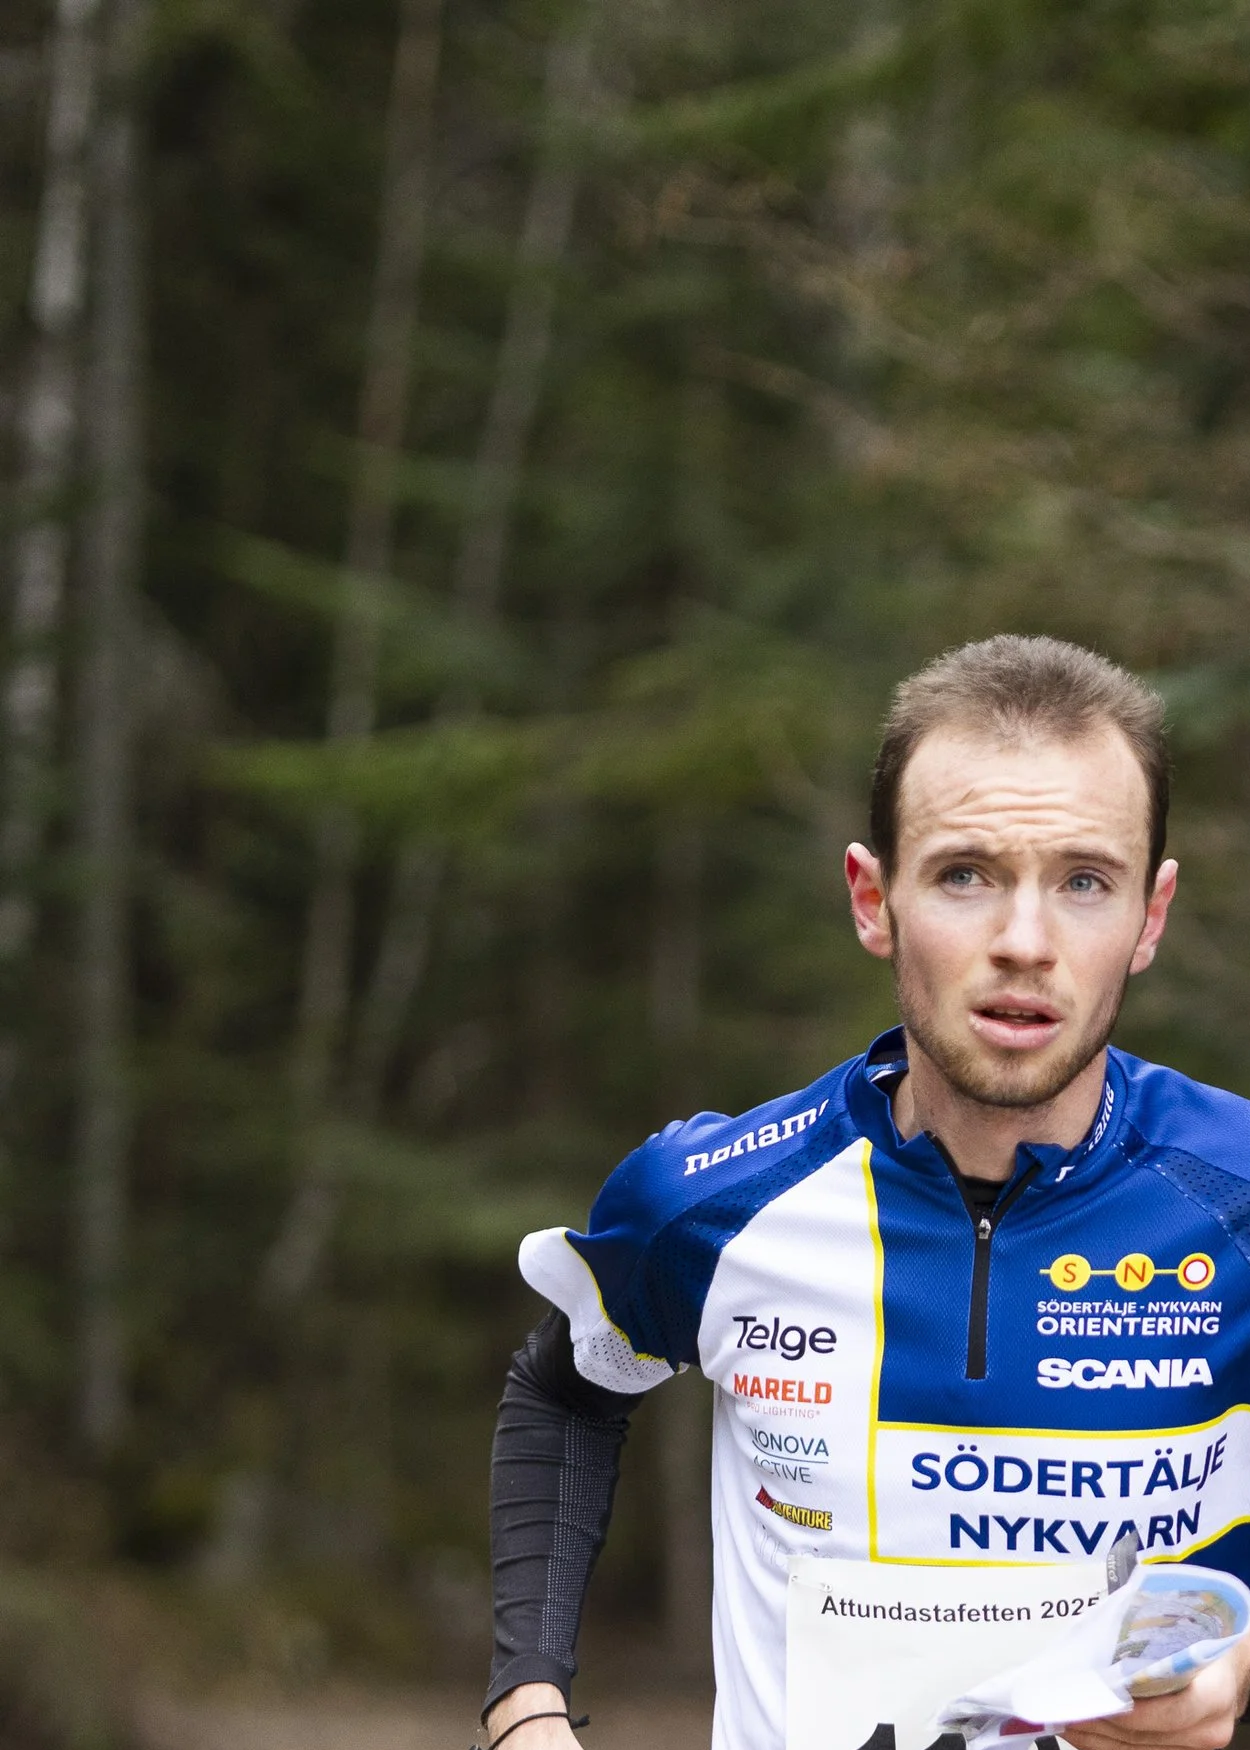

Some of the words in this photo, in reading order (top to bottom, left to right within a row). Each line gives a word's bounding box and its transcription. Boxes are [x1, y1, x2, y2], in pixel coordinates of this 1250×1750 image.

[683, 1098, 830, 1176] nonam
[1037, 1299, 1137, 1317] SÖDERTÄLJE
[1147, 1301, 1222, 1313] NYKVARN
[732, 1315, 837, 1361] Telge
[1036, 1316, 1220, 1336] ORIENTERING
[733, 1372, 833, 1405] MARELD
[1036, 1357, 1214, 1390] SCANIA
[911, 1432, 1228, 1498] SÖDERTÄLJE
[949, 1499, 1202, 1556] NYKVARN
[821, 1595, 1031, 1623] Attundastafetten
